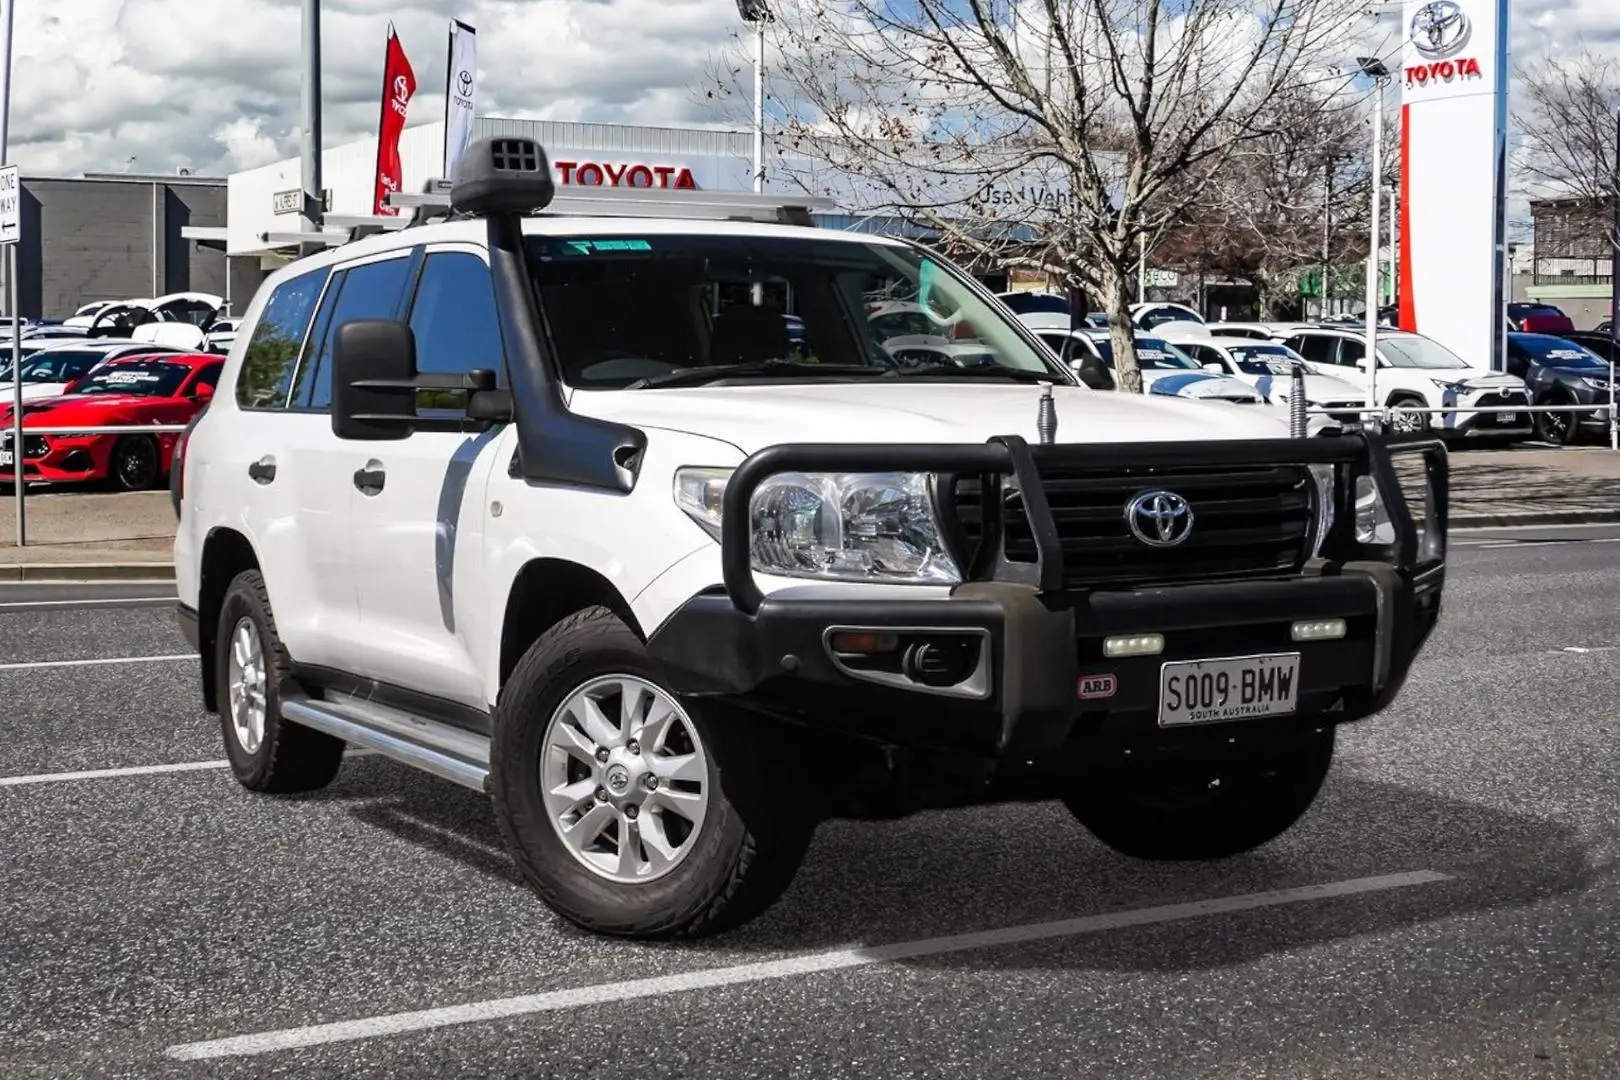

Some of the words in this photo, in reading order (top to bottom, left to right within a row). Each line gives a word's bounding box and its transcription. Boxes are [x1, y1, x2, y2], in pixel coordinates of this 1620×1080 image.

[1404, 58, 1480, 83] TOYOTA
[1, 173, 15, 191] ONE
[555, 161, 696, 190] TOYOTA
[0, 196, 16, 214] WAY
[1082, 679, 1112, 694] ARB
[1189, 708, 1220, 720] SOUTH
[1223, 703, 1270, 717] AUSTRALIA
